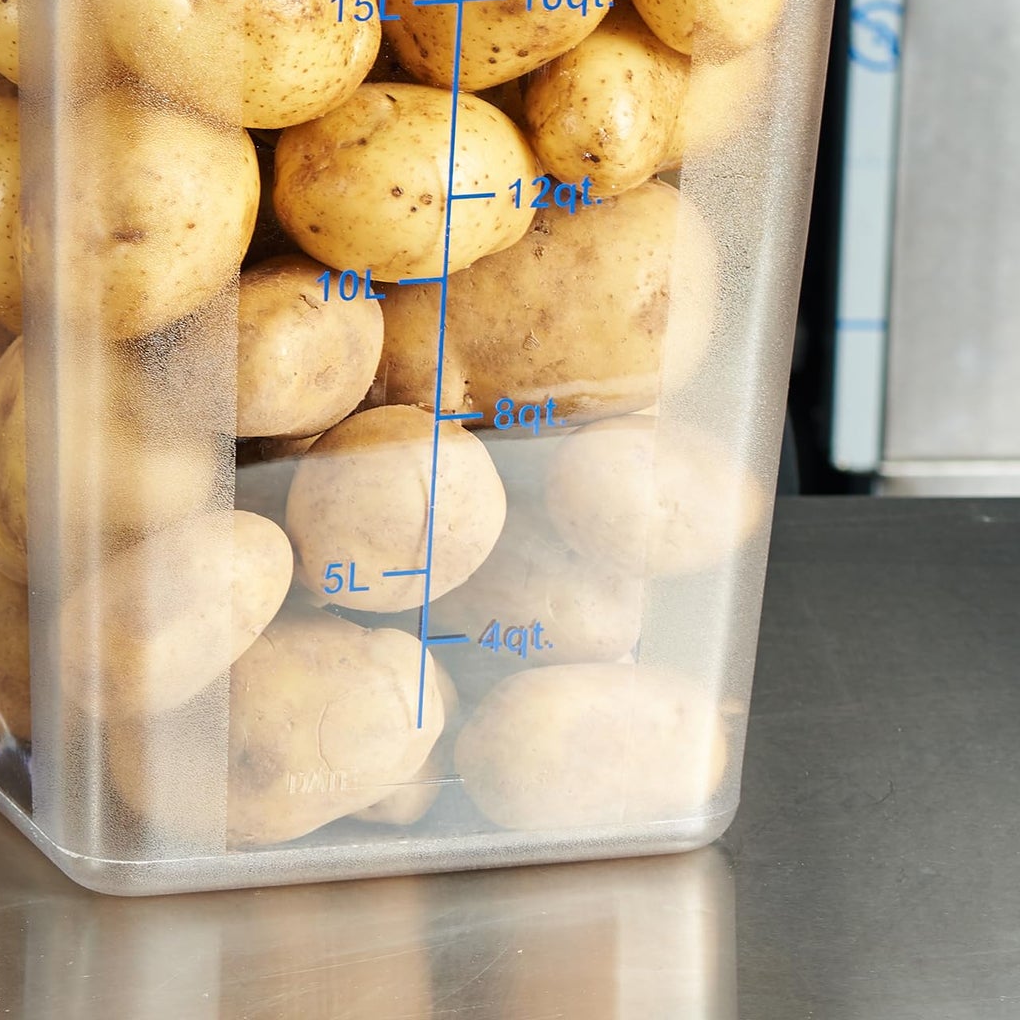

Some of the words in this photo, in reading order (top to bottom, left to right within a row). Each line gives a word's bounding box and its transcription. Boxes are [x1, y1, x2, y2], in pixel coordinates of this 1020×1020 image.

[508, 176, 604, 215] 12qt.
[316, 268, 386, 302] 10L
[493, 397, 568, 436] 8qt.
[323, 561, 370, 595] 5L
[480, 619, 554, 659] 4qt.
